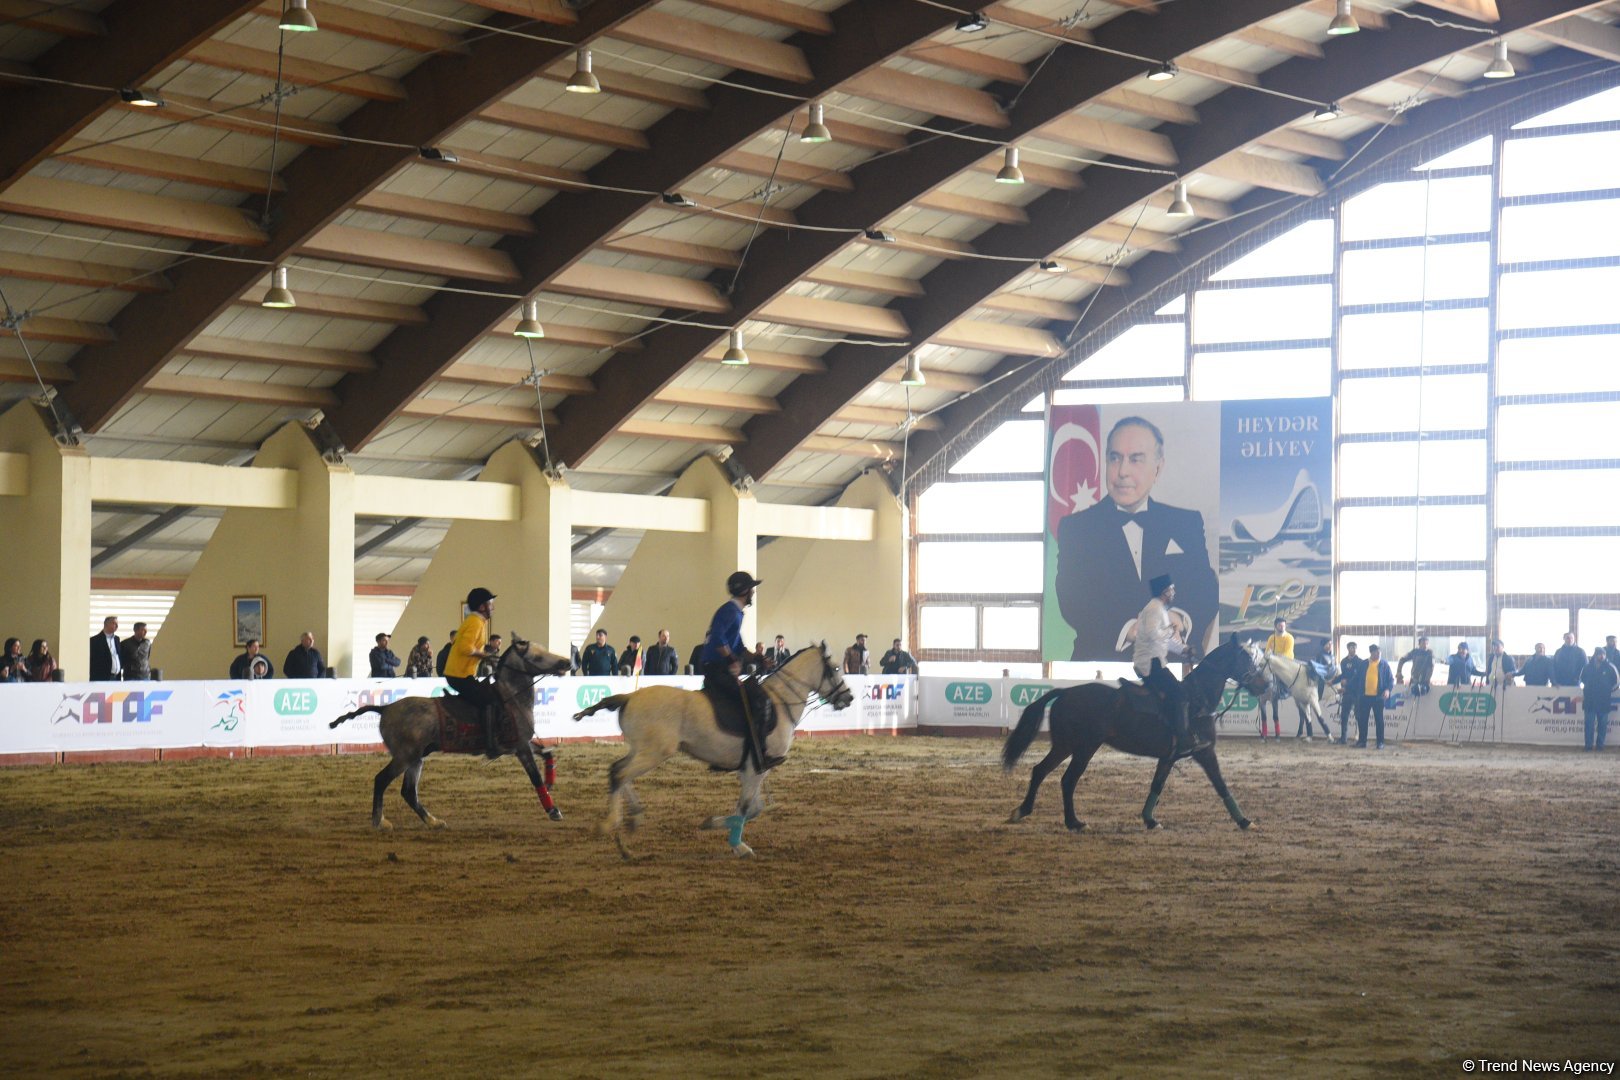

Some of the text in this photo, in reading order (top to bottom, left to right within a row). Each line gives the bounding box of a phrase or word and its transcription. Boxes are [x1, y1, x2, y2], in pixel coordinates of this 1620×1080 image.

[1237, 415, 1319, 433] HEYDƏR
[1241, 437, 1314, 457] ƏLİYEV
[281, 692, 310, 711] AZE
[952, 685, 984, 701] AZE
[1449, 696, 1487, 713] AZE
